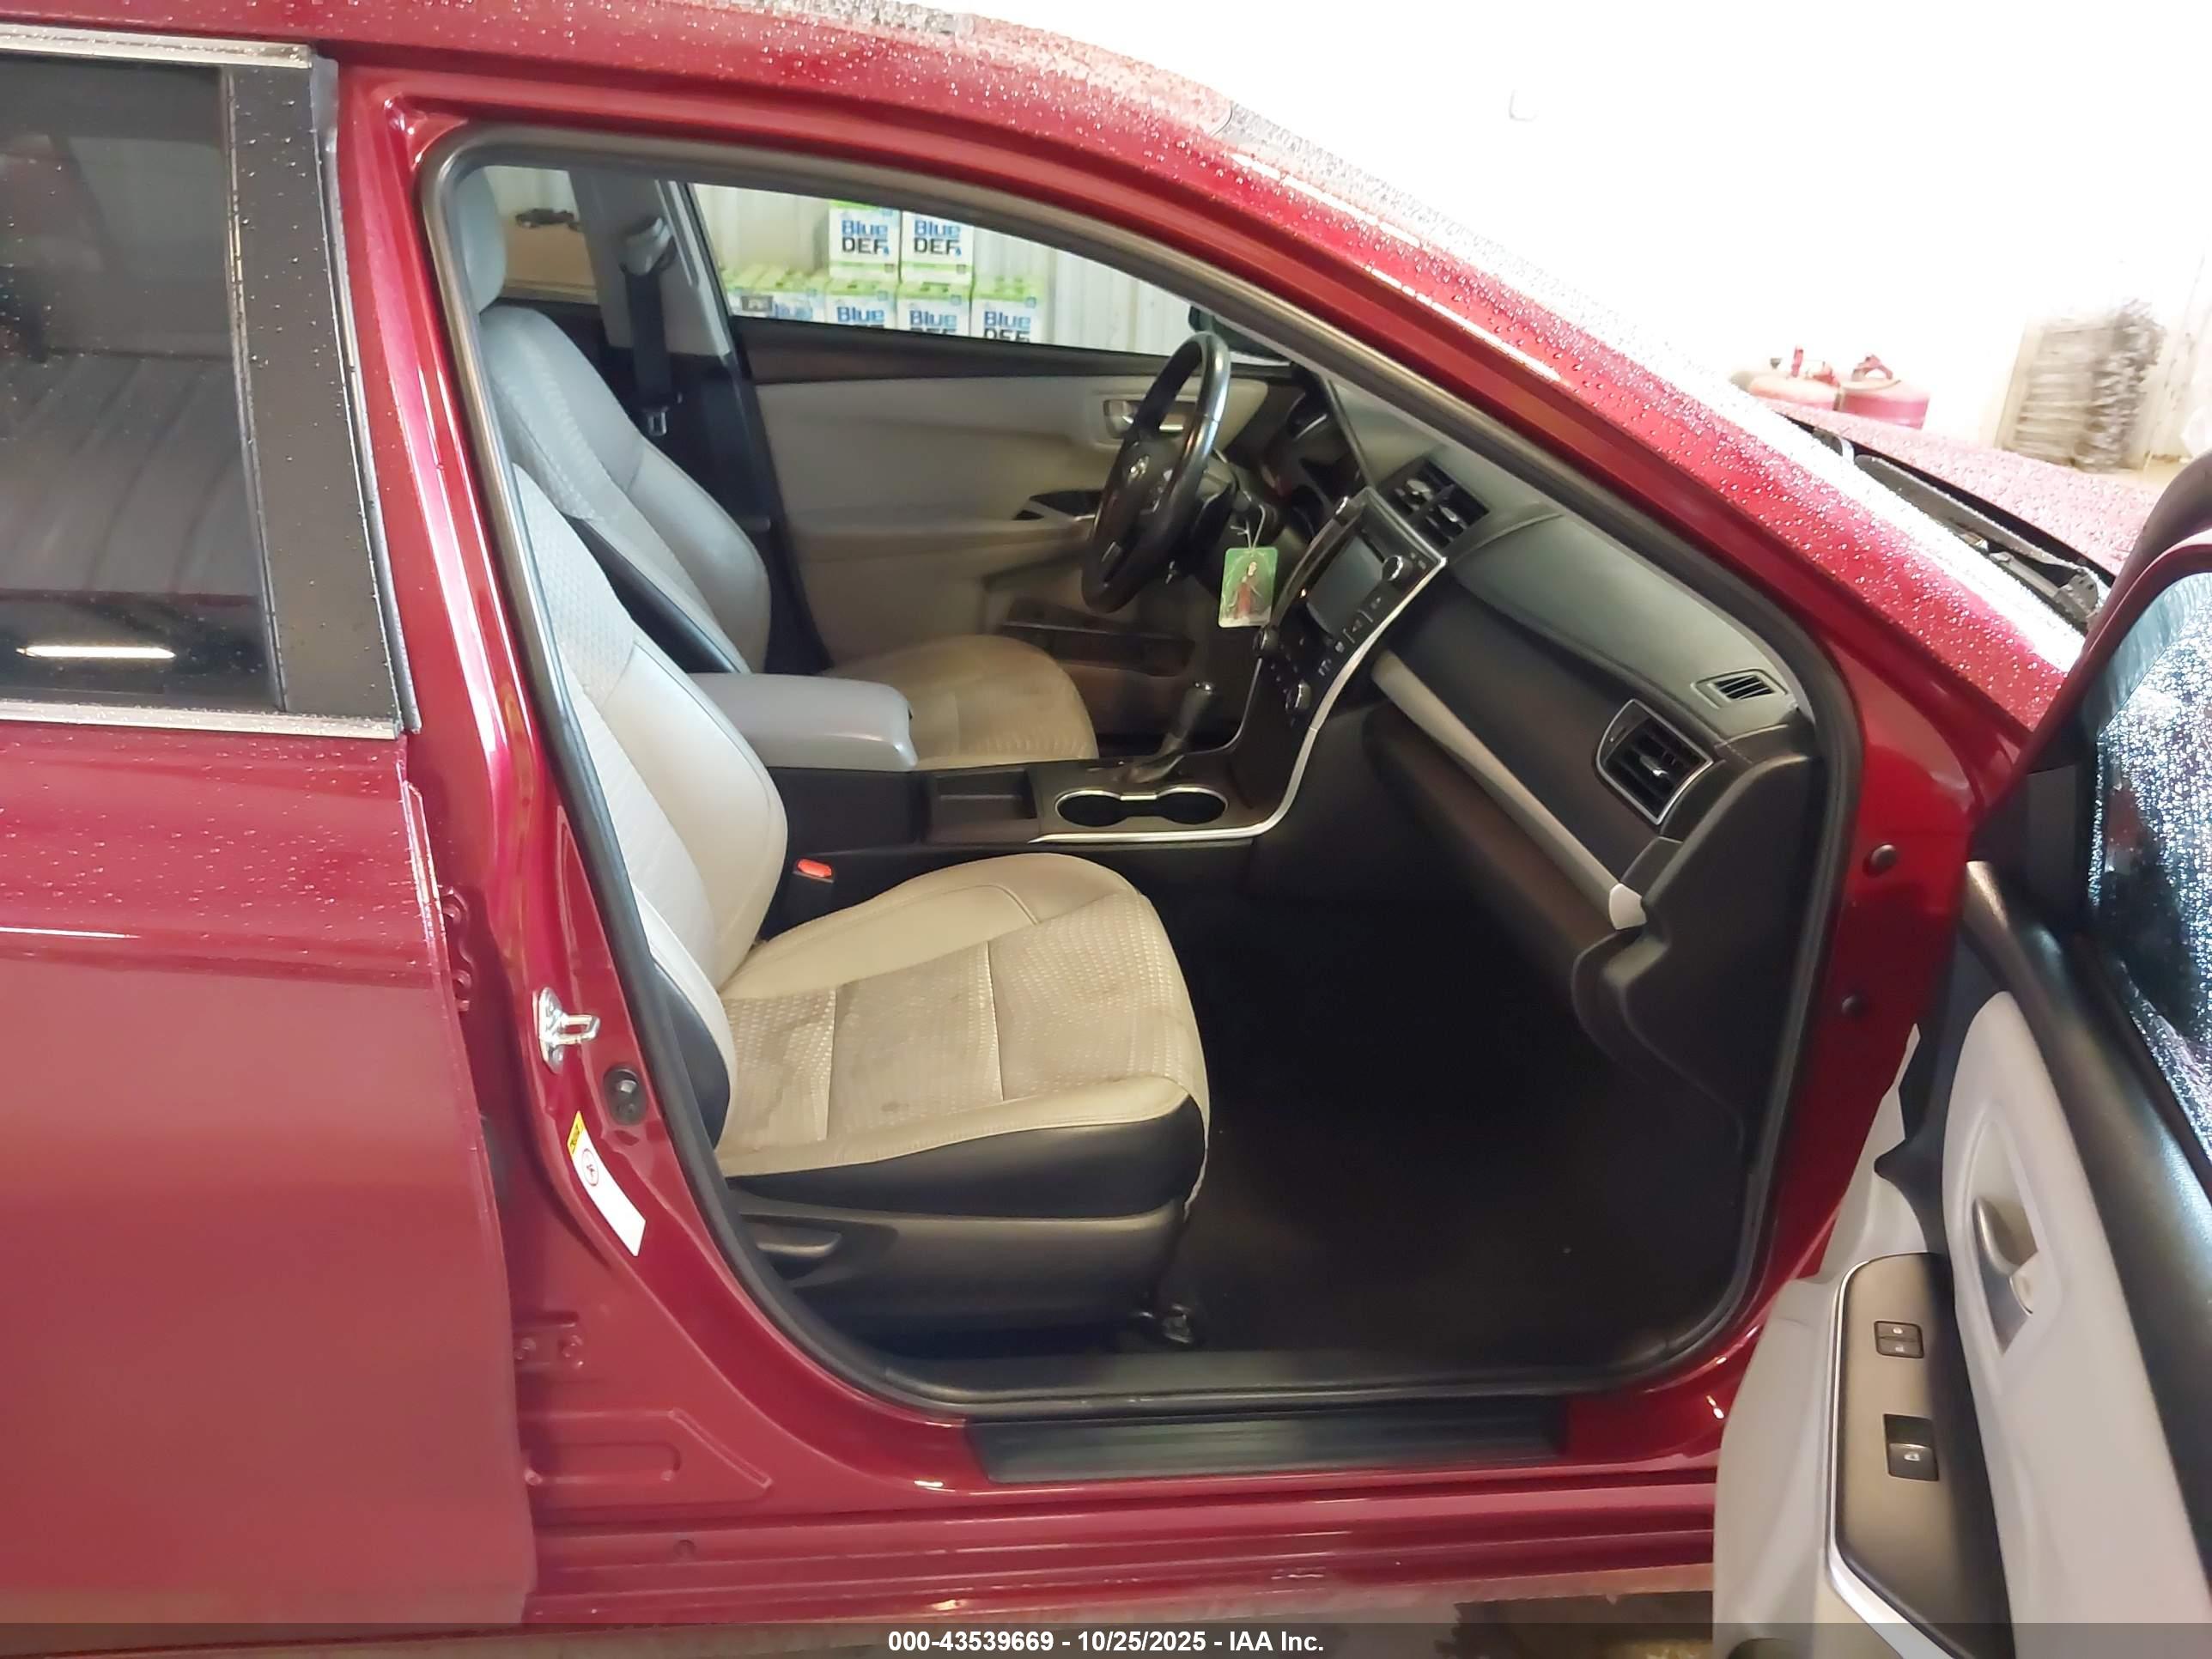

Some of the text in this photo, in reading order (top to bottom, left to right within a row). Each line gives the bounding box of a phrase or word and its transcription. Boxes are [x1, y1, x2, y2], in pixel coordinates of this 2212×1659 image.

[842, 220, 888, 237] Blue
[914, 220, 961, 237] Blue
[842, 237, 889, 254] DEF
[914, 238, 961, 255] DEF
[836, 307, 884, 323] Blue
[909, 310, 957, 327] Blue
[984, 311, 1031, 330] Blue
